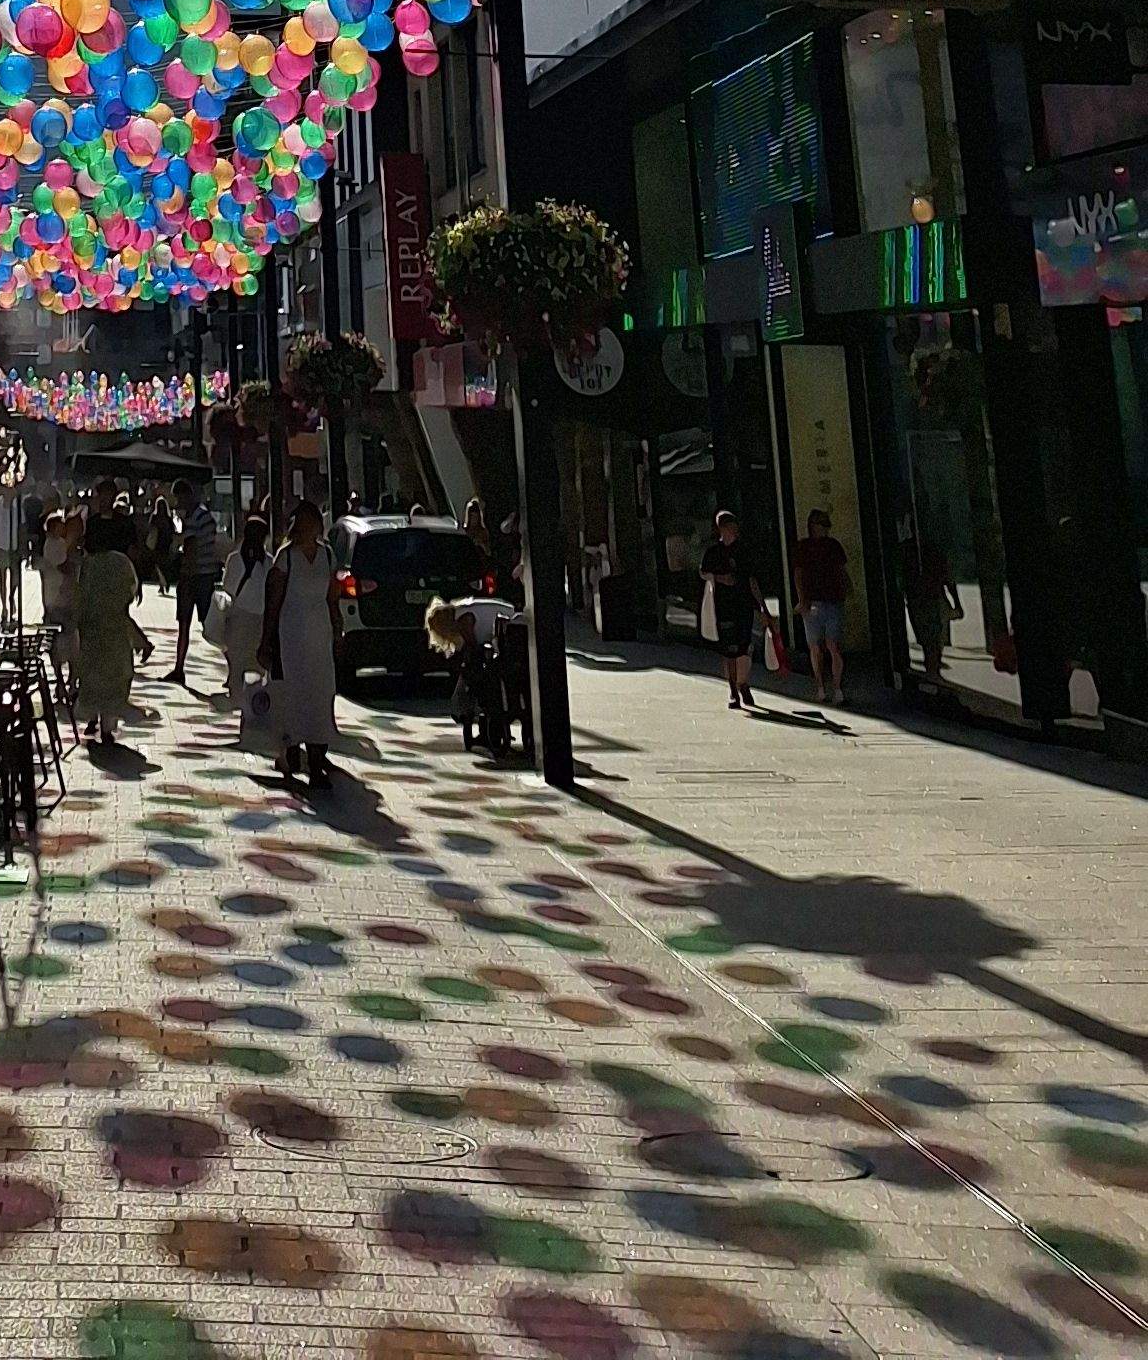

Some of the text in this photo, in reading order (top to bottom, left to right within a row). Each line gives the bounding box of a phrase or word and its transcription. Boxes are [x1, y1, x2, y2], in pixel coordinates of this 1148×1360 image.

[1036, 20, 1113, 43] NYX
[1067, 189, 1119, 236] NYX
[394, 187, 429, 303] REPLAY
